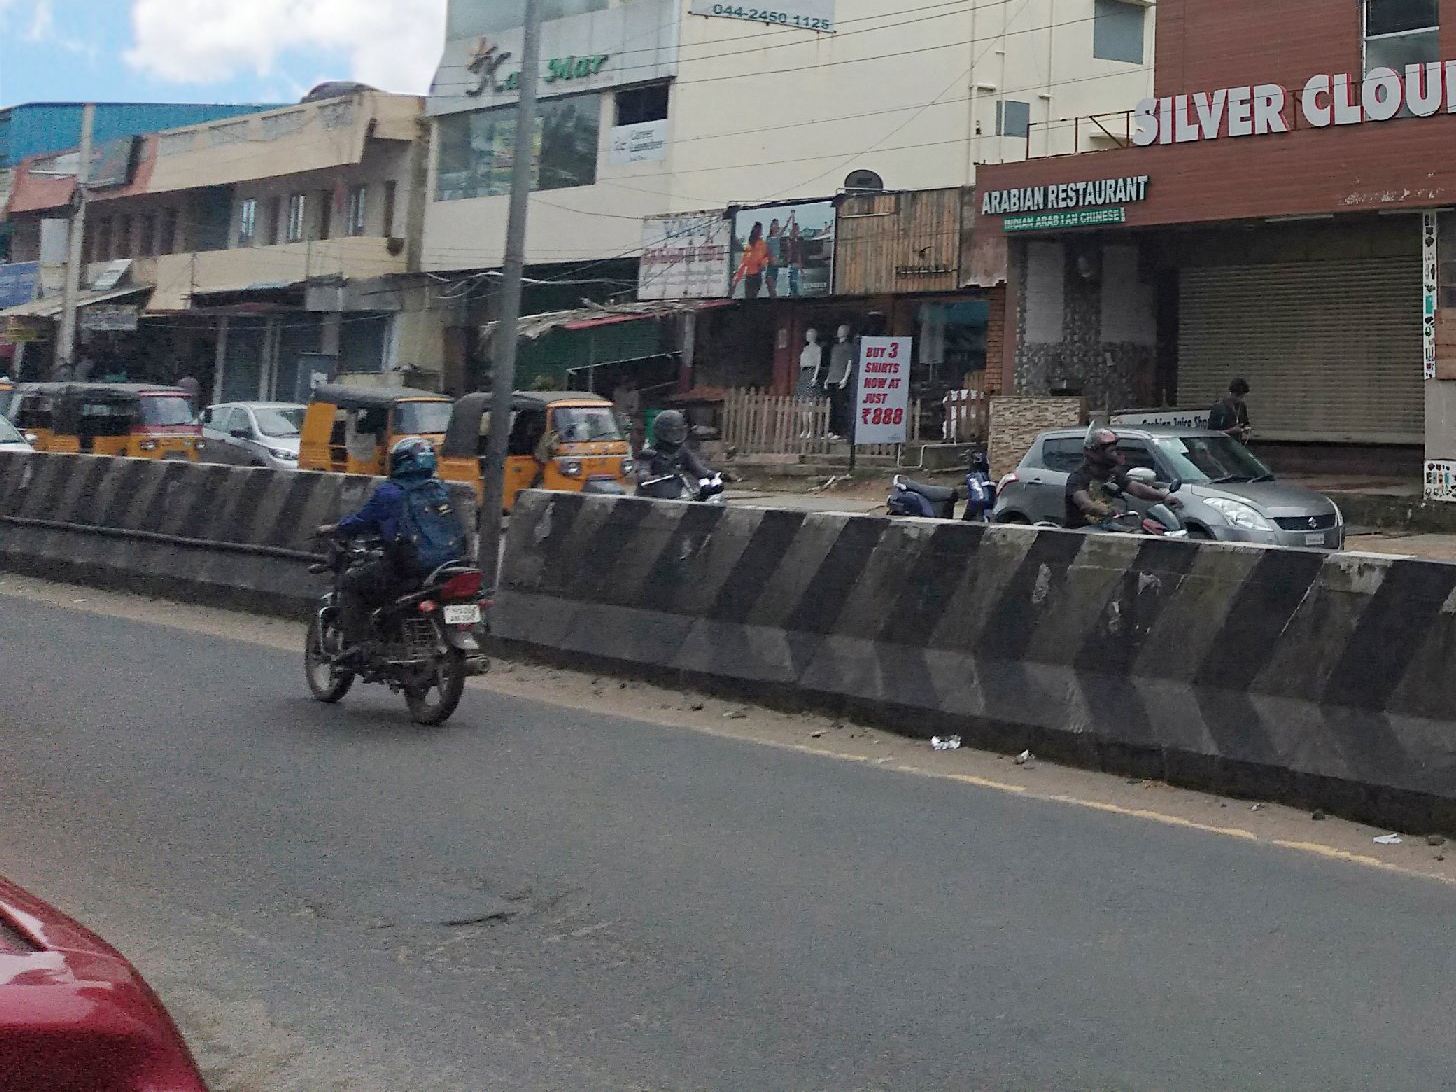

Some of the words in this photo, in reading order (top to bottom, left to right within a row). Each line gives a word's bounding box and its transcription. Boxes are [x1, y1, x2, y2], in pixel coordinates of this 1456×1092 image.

[713, 4, 787, 23] 044-2450
[791, 14, 830, 29] 1125
[1133, 83, 1291, 146] SILVER
[982, 186, 1044, 215] ARABIAN
[1048, 175, 1149, 209] RESTAURANT
[1004, 217, 1034, 229] INDIAN
[1079, 209, 1120, 223] CHINESE
[866, 347, 886, 358] BUY
[888, 342, 899, 358] 3
[864, 362, 900, 374] SHIRTS
[864, 378, 887, 388] NOW
[888, 378, 901, 388] AT
[863, 393, 888, 404] JUST
[861, 407, 903, 425] ₹888
